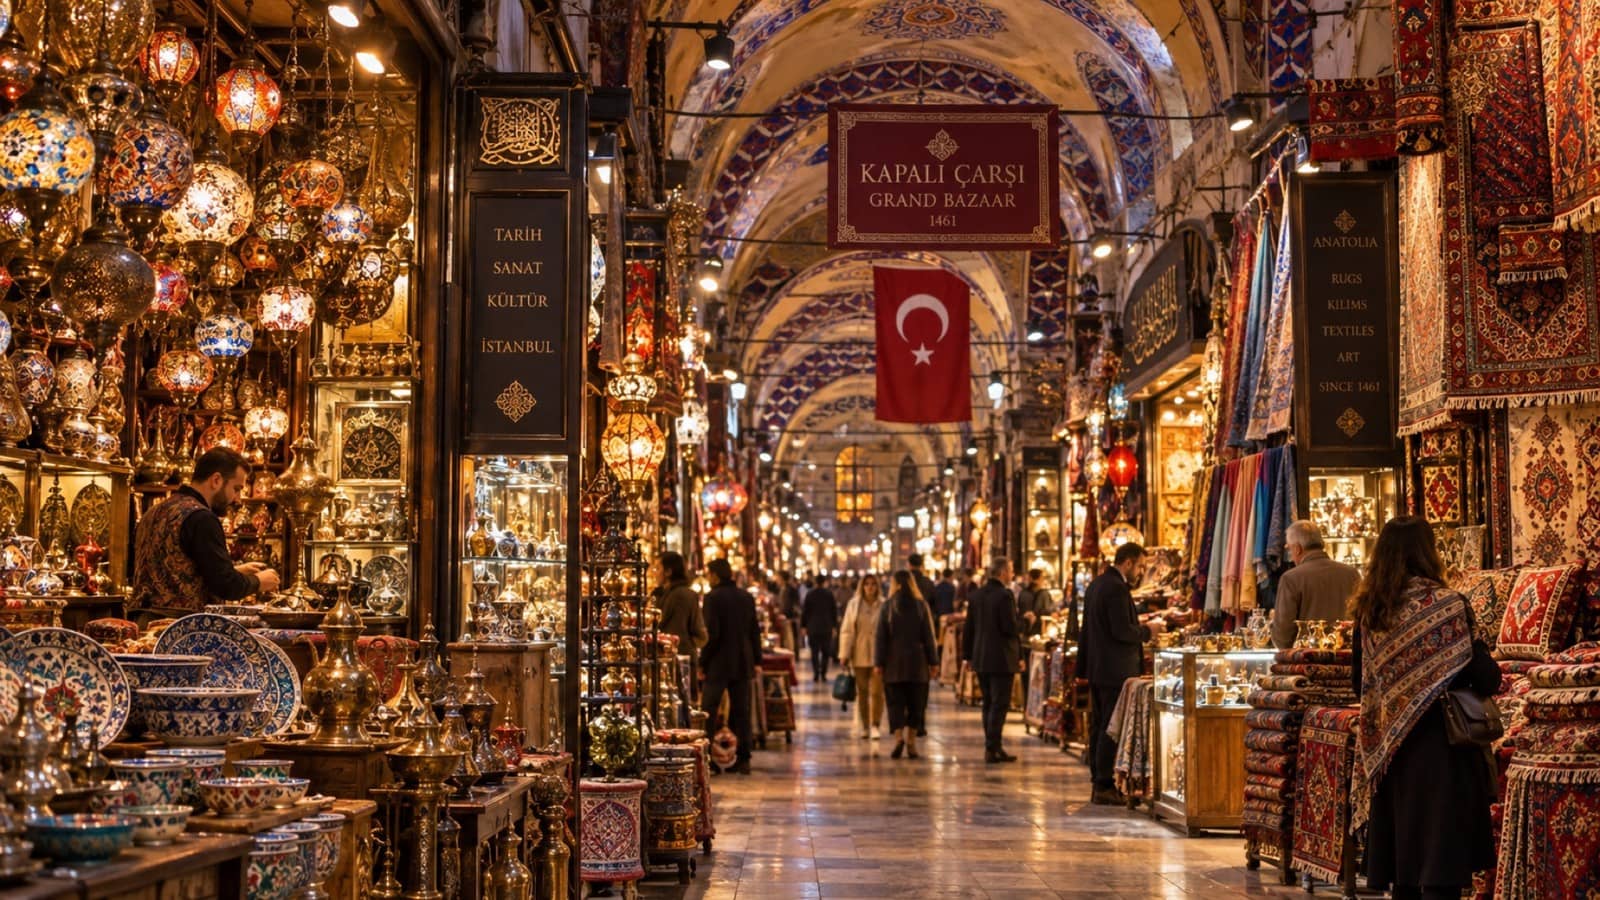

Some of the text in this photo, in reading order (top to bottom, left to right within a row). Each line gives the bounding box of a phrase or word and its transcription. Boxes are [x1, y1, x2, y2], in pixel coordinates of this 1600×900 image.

[861, 163, 1024, 188] KAPALI ÇARŞI
[869, 193, 1016, 207] GRAND BAZAAR
[930, 215, 957, 226] 1461
[494, 225, 542, 241] TARİH
[1313, 236, 1378, 248] ANATOLIA
[493, 261, 543, 274] SANAT
[1331, 273, 1362, 284] RUGS
[487, 292, 548, 307] KÜLTÜR
[1328, 299, 1367, 310] KILIMS
[1322, 325, 1374, 336] TEXTILES
[481, 337, 554, 353] İSTANBUL
[1336, 352, 1360, 362] ART
[1319, 381, 1380, 392] SINCE 1461
